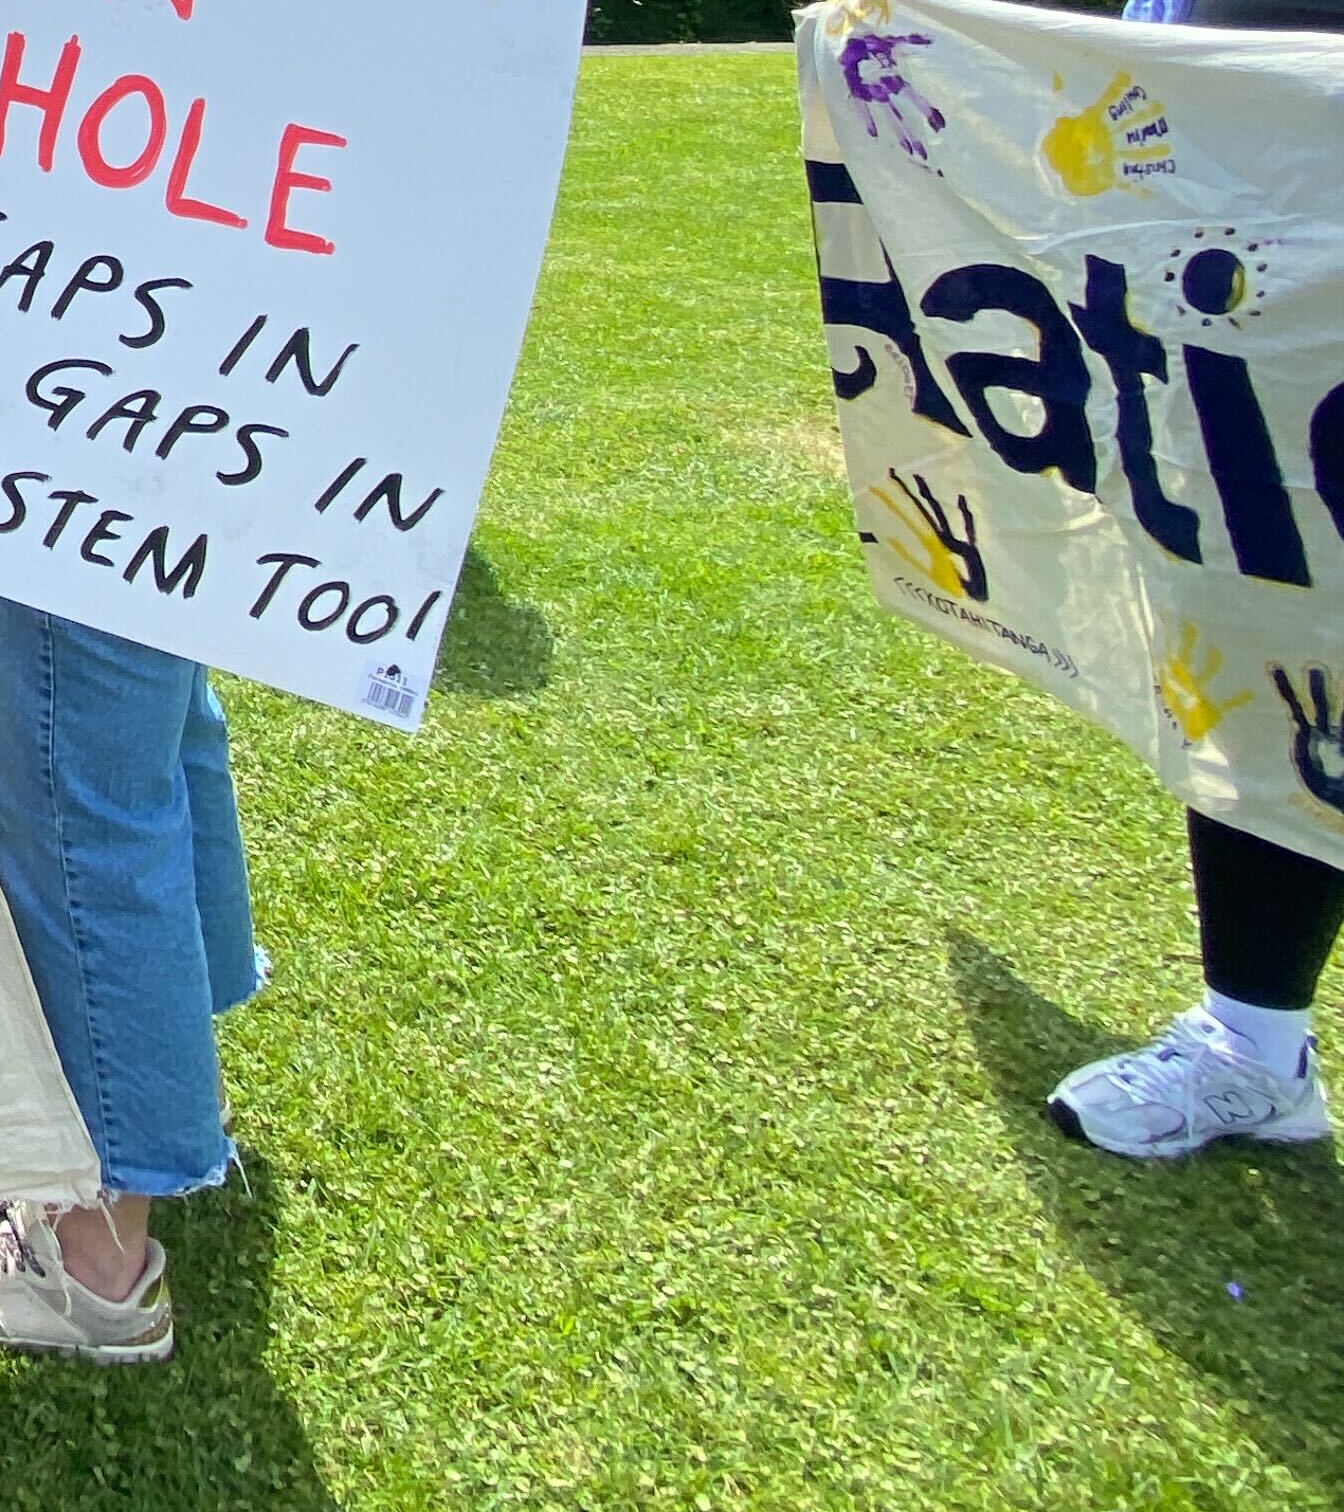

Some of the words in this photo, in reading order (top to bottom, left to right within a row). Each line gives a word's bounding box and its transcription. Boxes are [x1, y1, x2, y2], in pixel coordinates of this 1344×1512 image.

[219, 315, 361, 398] IN
[25, 358, 290, 487] GAPS
[314, 457, 445, 533] IN
[249, 553, 443, 677] TOO!
